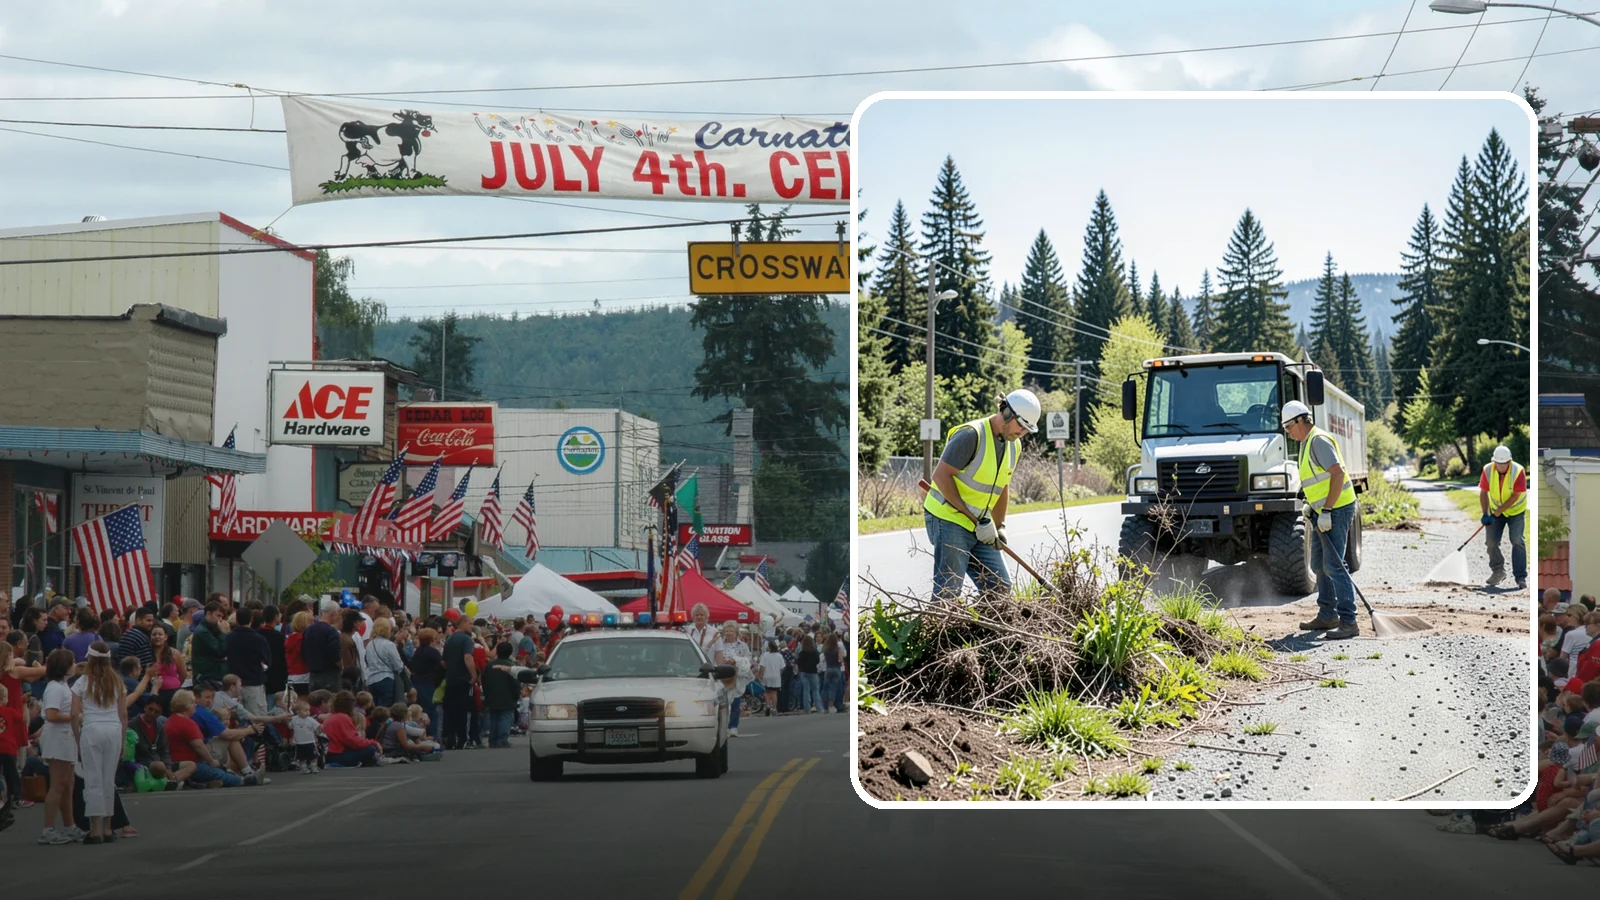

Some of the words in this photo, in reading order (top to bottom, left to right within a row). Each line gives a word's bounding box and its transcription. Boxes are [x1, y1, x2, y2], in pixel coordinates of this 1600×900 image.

[481, 141, 605, 193] JULY
[632, 150, 746, 198] 4th.
[697, 254, 850, 280] CROSSWA
[282, 380, 374, 420] ACE
[406, 409, 453, 422] CEDAR
[283, 421, 371, 437] Hardware
[416, 428, 477, 447] Coca-Cola
[95, 485, 124, 495] Vincent
[126, 485, 135, 495] de
[137, 485, 155, 495] Paul
[688, 526, 741, 535] CRNATION
[699, 535, 730, 543] GLASS
